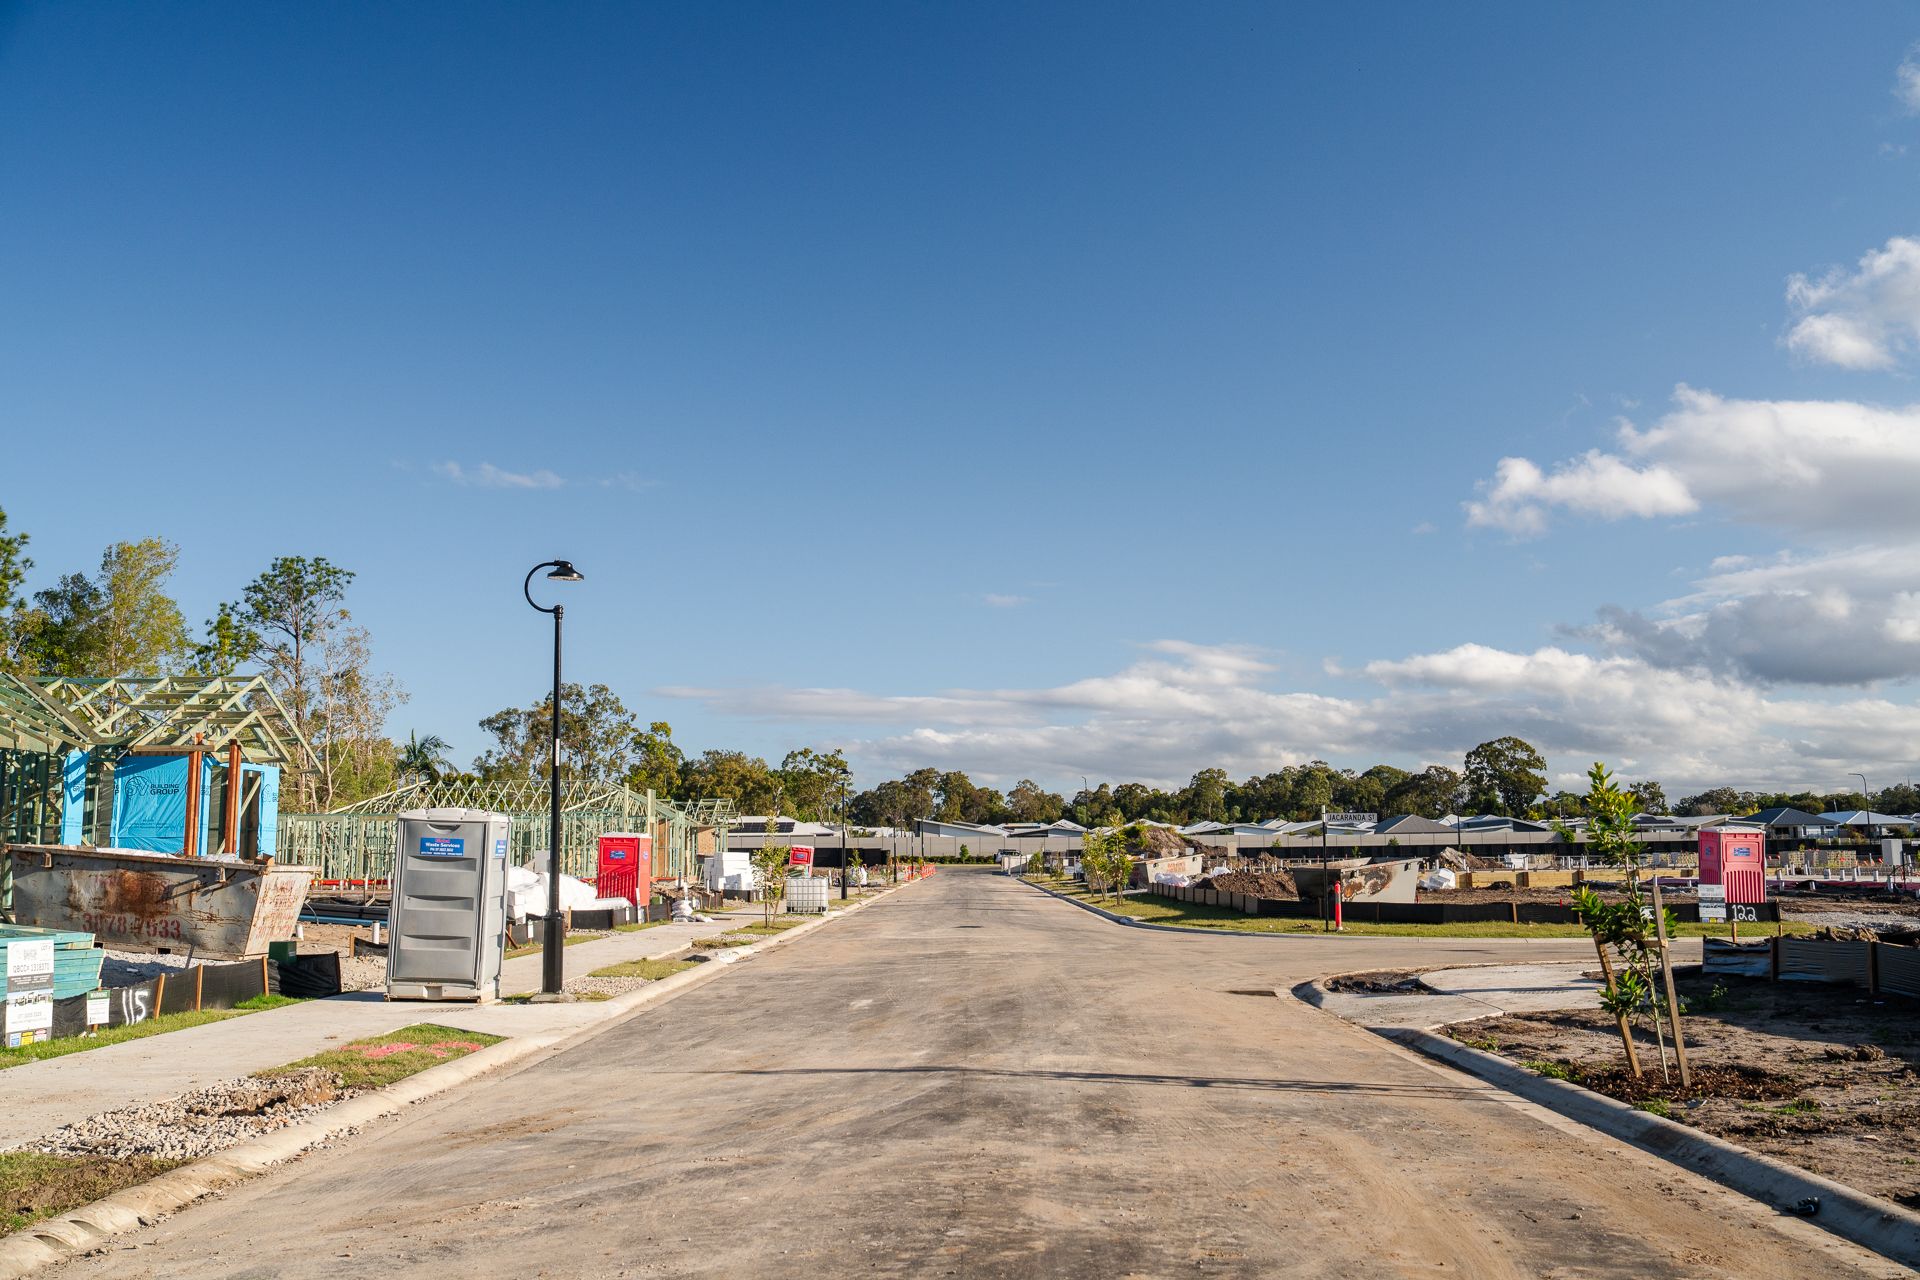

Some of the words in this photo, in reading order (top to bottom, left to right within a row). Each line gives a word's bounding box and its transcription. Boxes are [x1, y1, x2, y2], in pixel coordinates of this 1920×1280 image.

[150, 788, 180, 796] GROUP
[1732, 904, 1758, 922] 122
[122, 989, 149, 1027] 115
